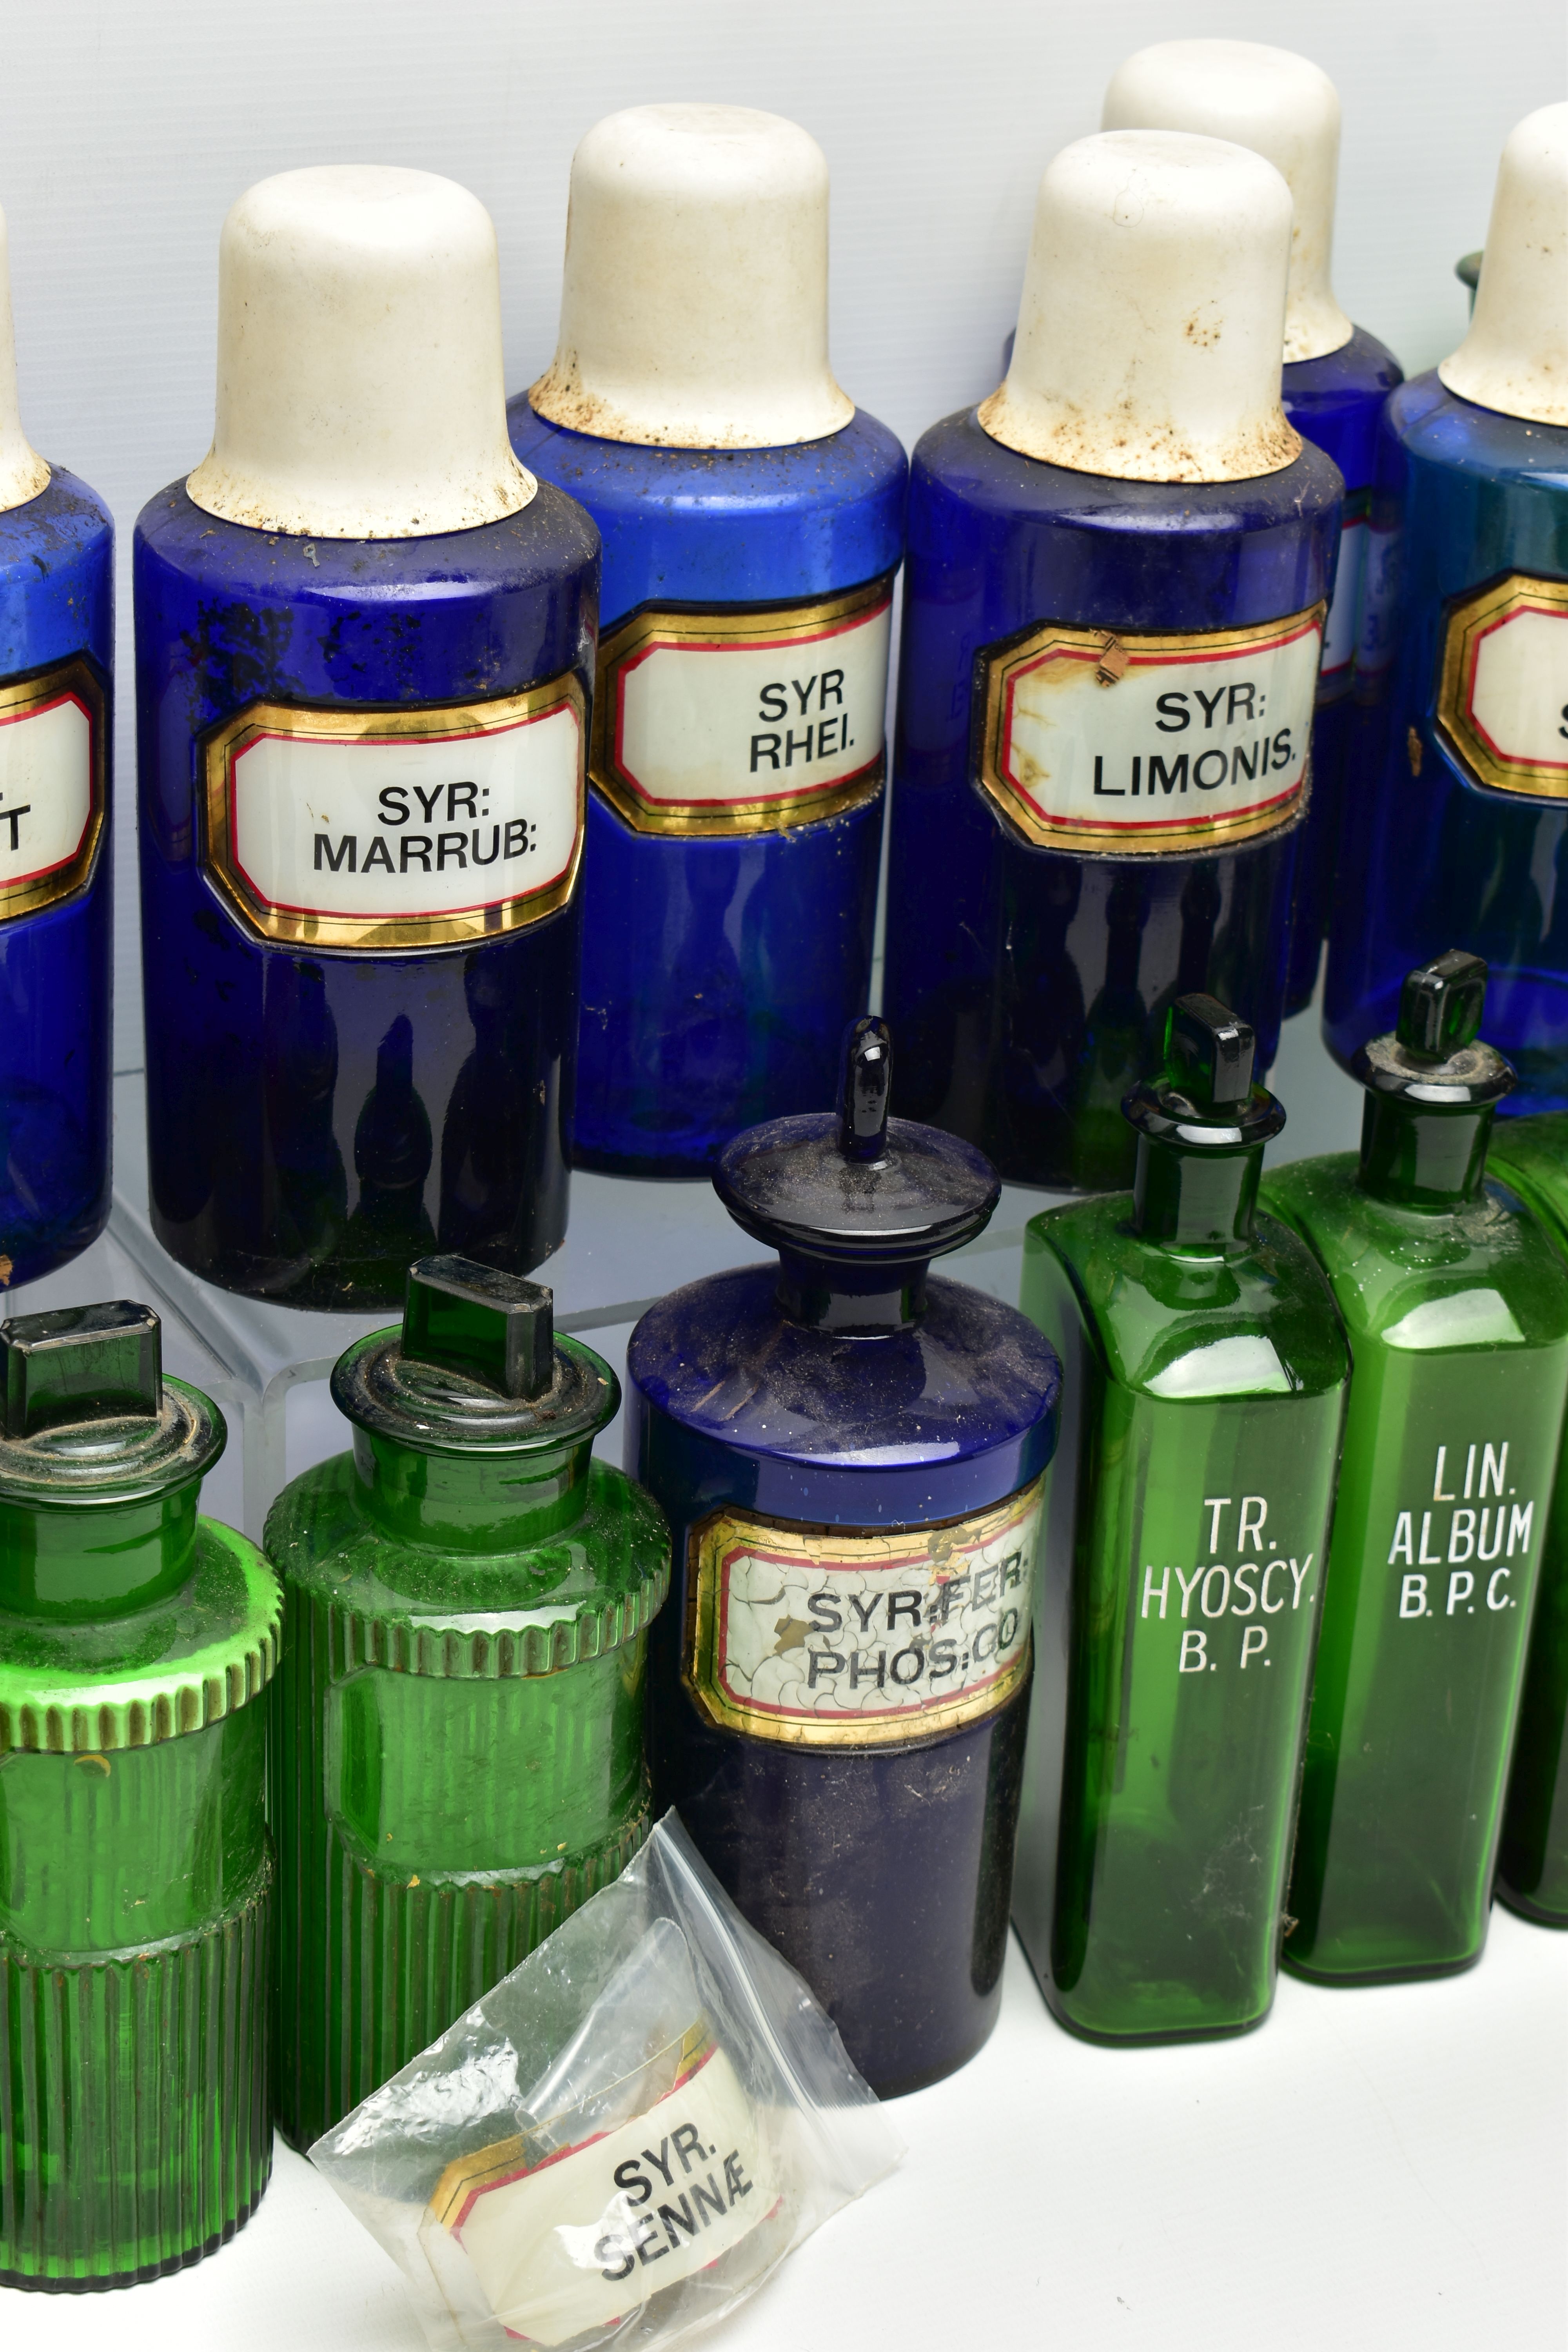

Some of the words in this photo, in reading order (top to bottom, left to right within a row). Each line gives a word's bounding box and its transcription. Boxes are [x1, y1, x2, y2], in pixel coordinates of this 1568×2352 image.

[759, 669, 844, 722] SYR
[1154, 682, 1266, 733] SYR:
[750, 712, 854, 773] RHEI.
[1093, 728, 1296, 796] LIMONIS.
[377, 781, 490, 826] SYR:
[314, 818, 536, 873] MARRUB:
[1433, 1441, 1515, 1501] LIN.
[1204, 1496, 1276, 1554] TR.
[1387, 1500, 1534, 1565] ALBUM
[1141, 1553, 1314, 1619] HYOSCY.
[613, 2122, 717, 2207] SYR.
[593, 2149, 754, 2281] SENNÆ
